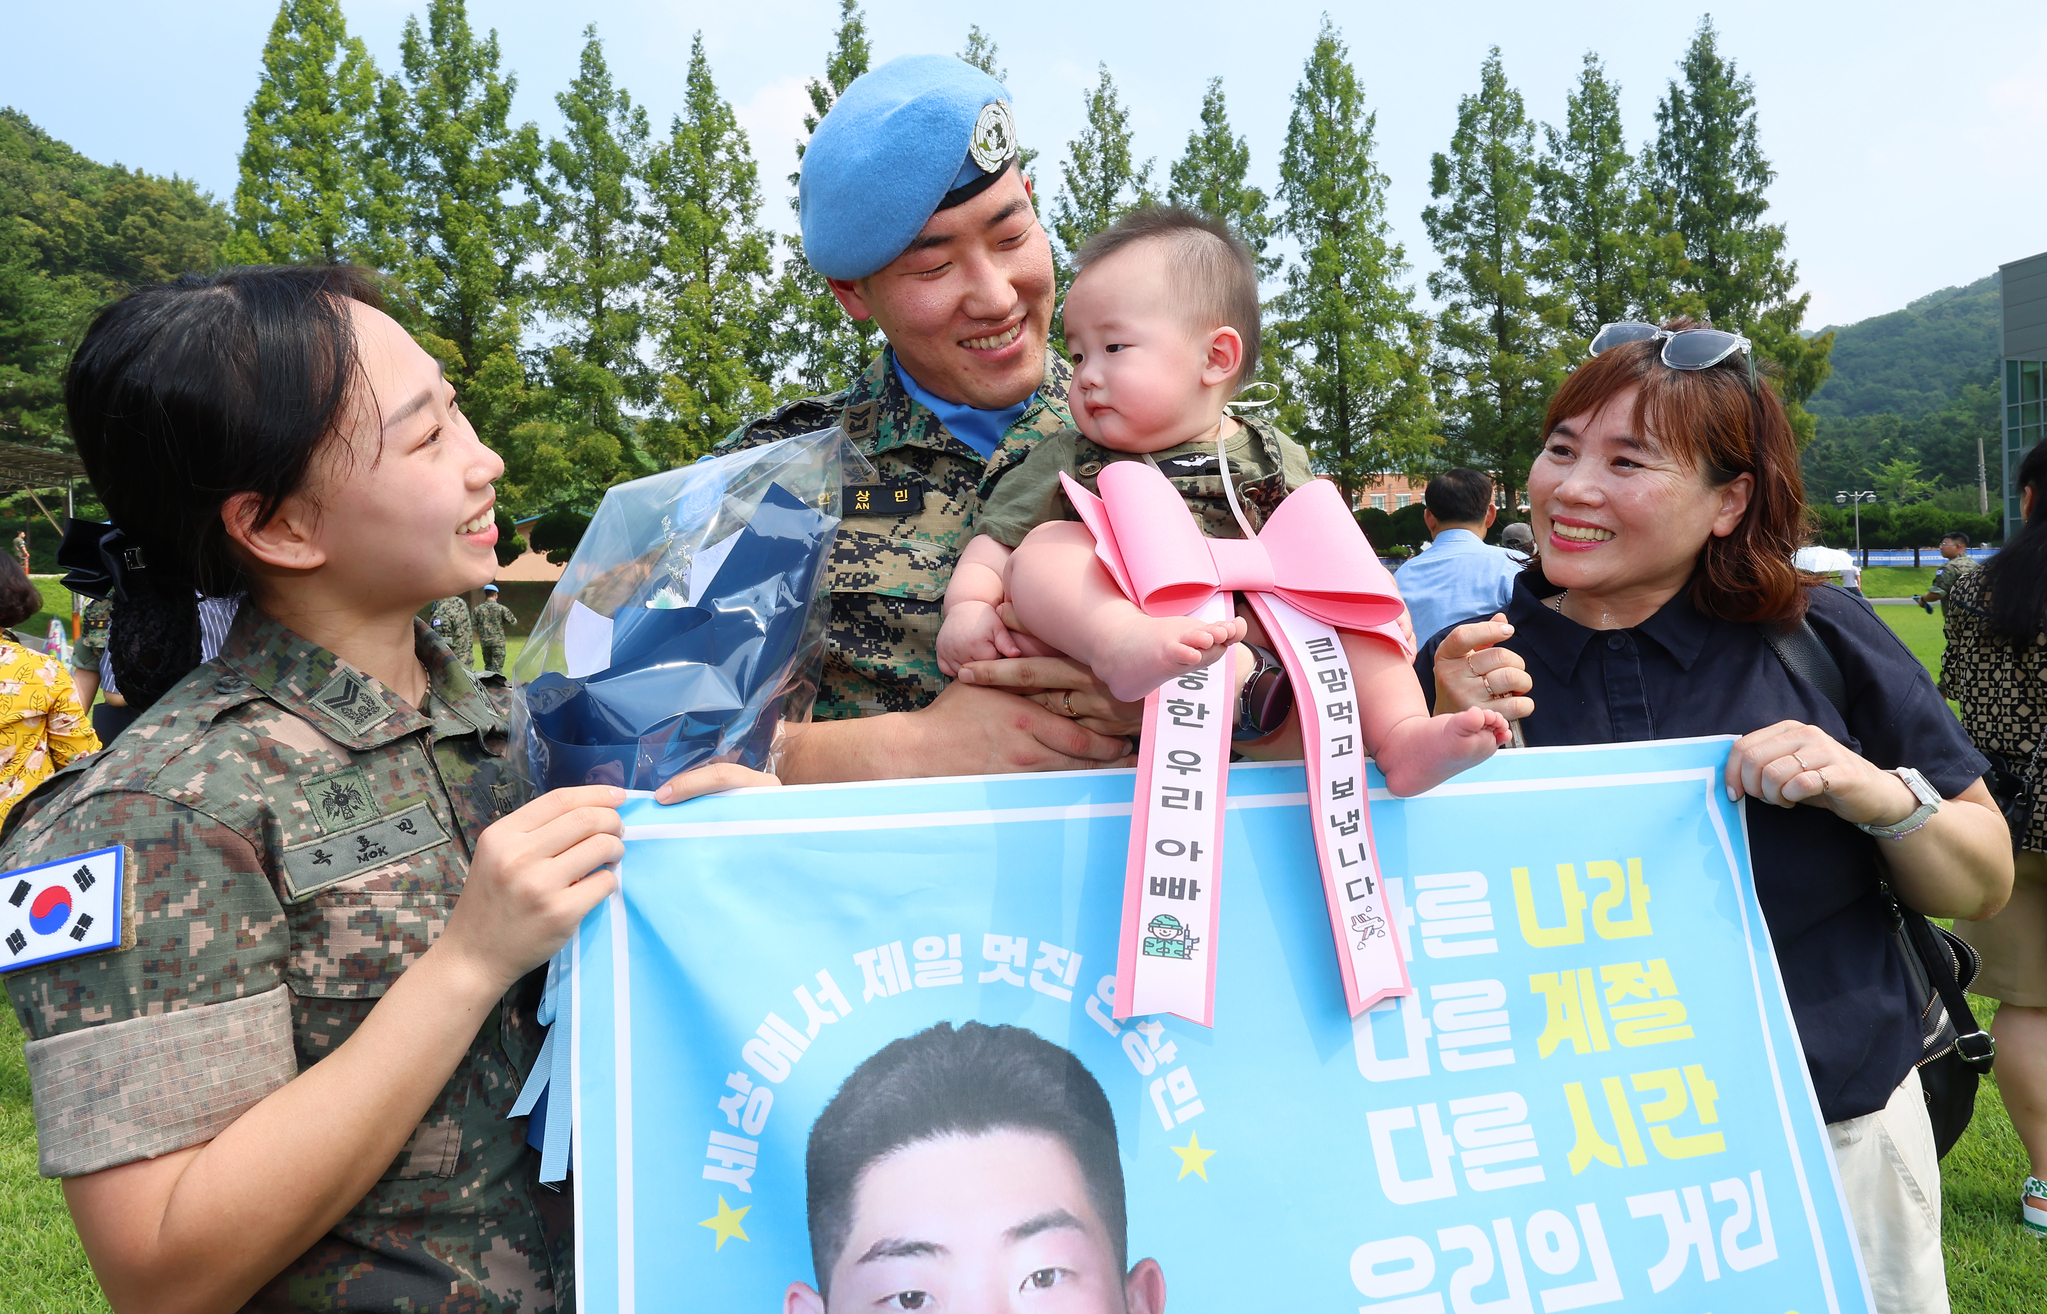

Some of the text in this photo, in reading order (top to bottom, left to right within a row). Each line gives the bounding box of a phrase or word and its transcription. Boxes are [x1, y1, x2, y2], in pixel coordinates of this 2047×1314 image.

[855, 490, 871, 502] 상
[894, 489, 909, 502] 민
[855, 502, 870, 510] AN
[1161, 750, 1203, 811] 우리
[357, 846, 389, 864] MOK
[1150, 839, 1203, 901] 아빠
[1330, 777, 1375, 902] 보냅니다
[1510, 857, 1653, 948] 나라
[702, 968, 853, 1194] 세상에서
[853, 933, 964, 1004] 제일
[978, 933, 1083, 1003] 멋진
[1351, 958, 1696, 1083] 다른 계절
[1366, 1064, 1727, 1206] 다른 시간
[1625, 1170, 1779, 1294] 거리
